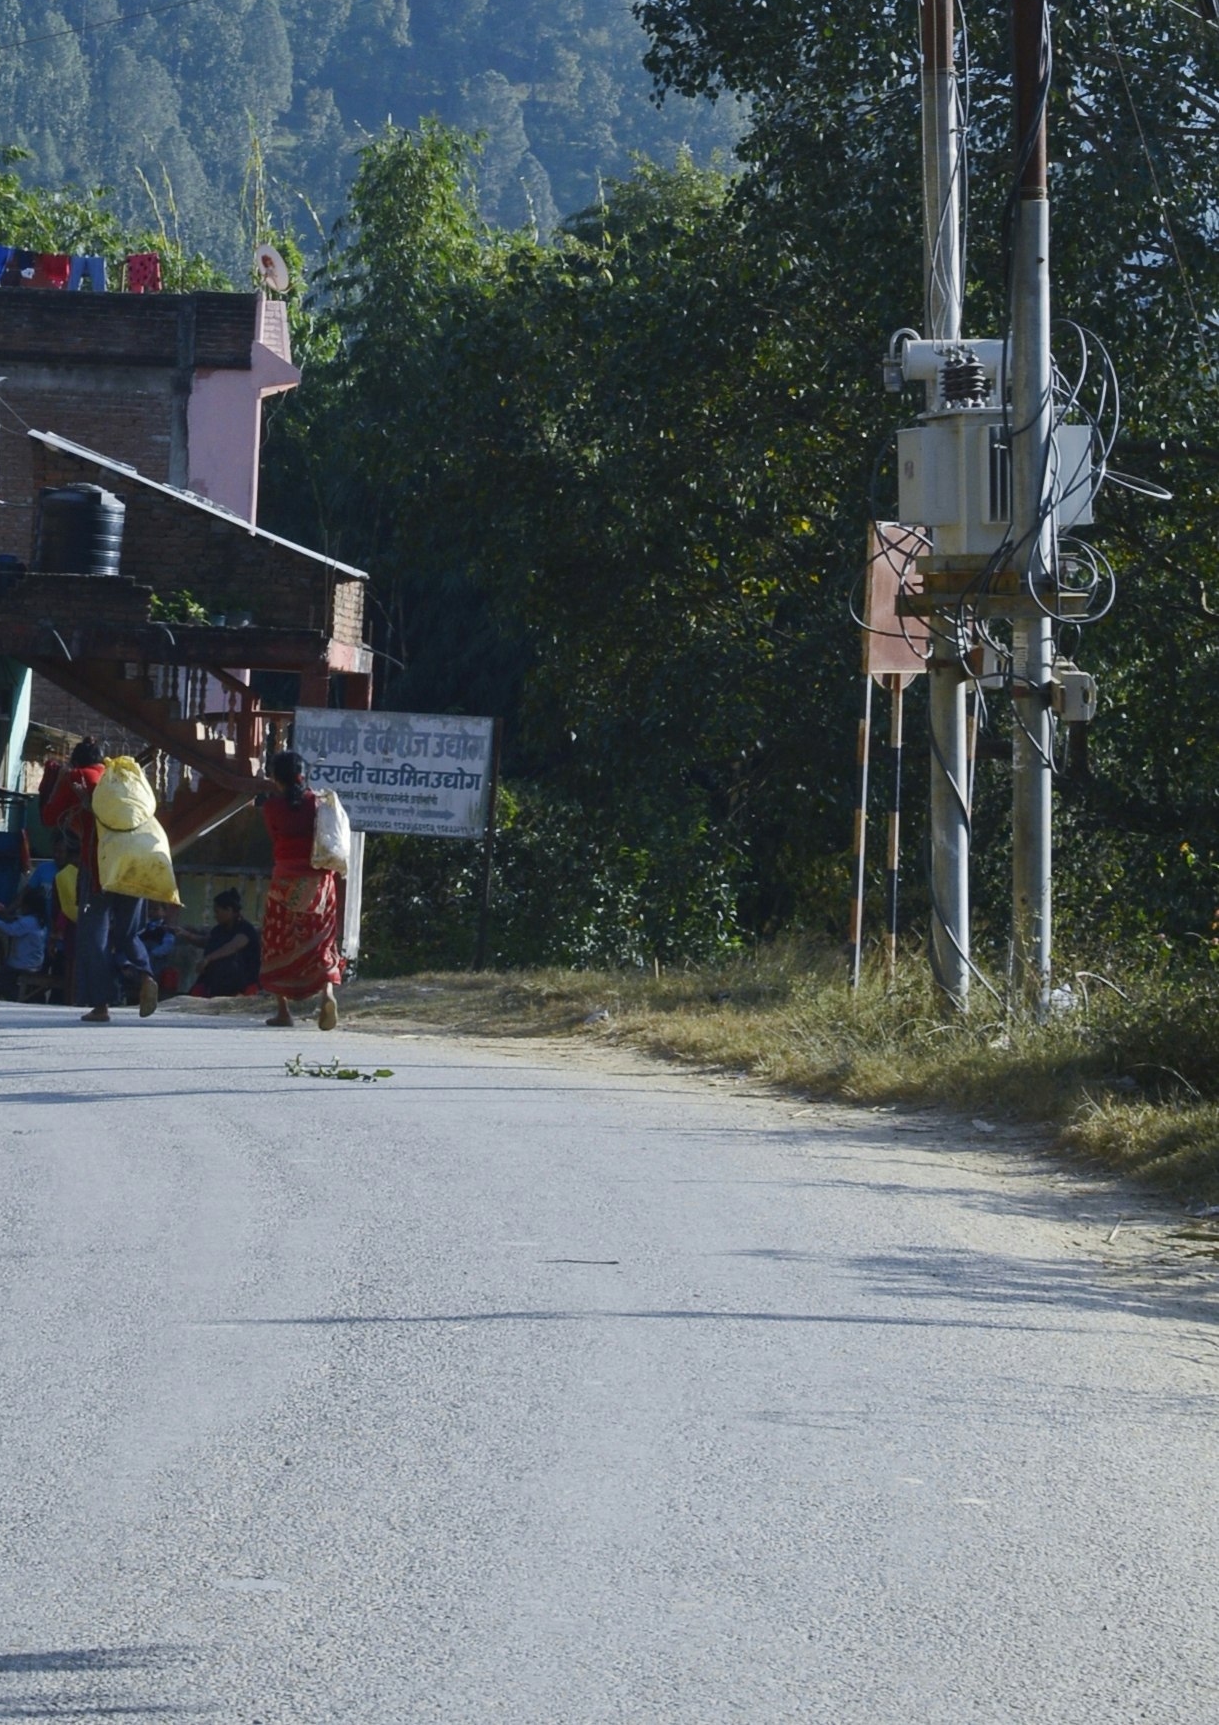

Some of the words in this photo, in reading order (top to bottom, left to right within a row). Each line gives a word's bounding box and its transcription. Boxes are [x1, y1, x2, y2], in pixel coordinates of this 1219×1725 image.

[305, 761, 363, 785] उराली
[366, 763, 430, 788] चाउमिन
[430, 767, 482, 791] उद्योग
